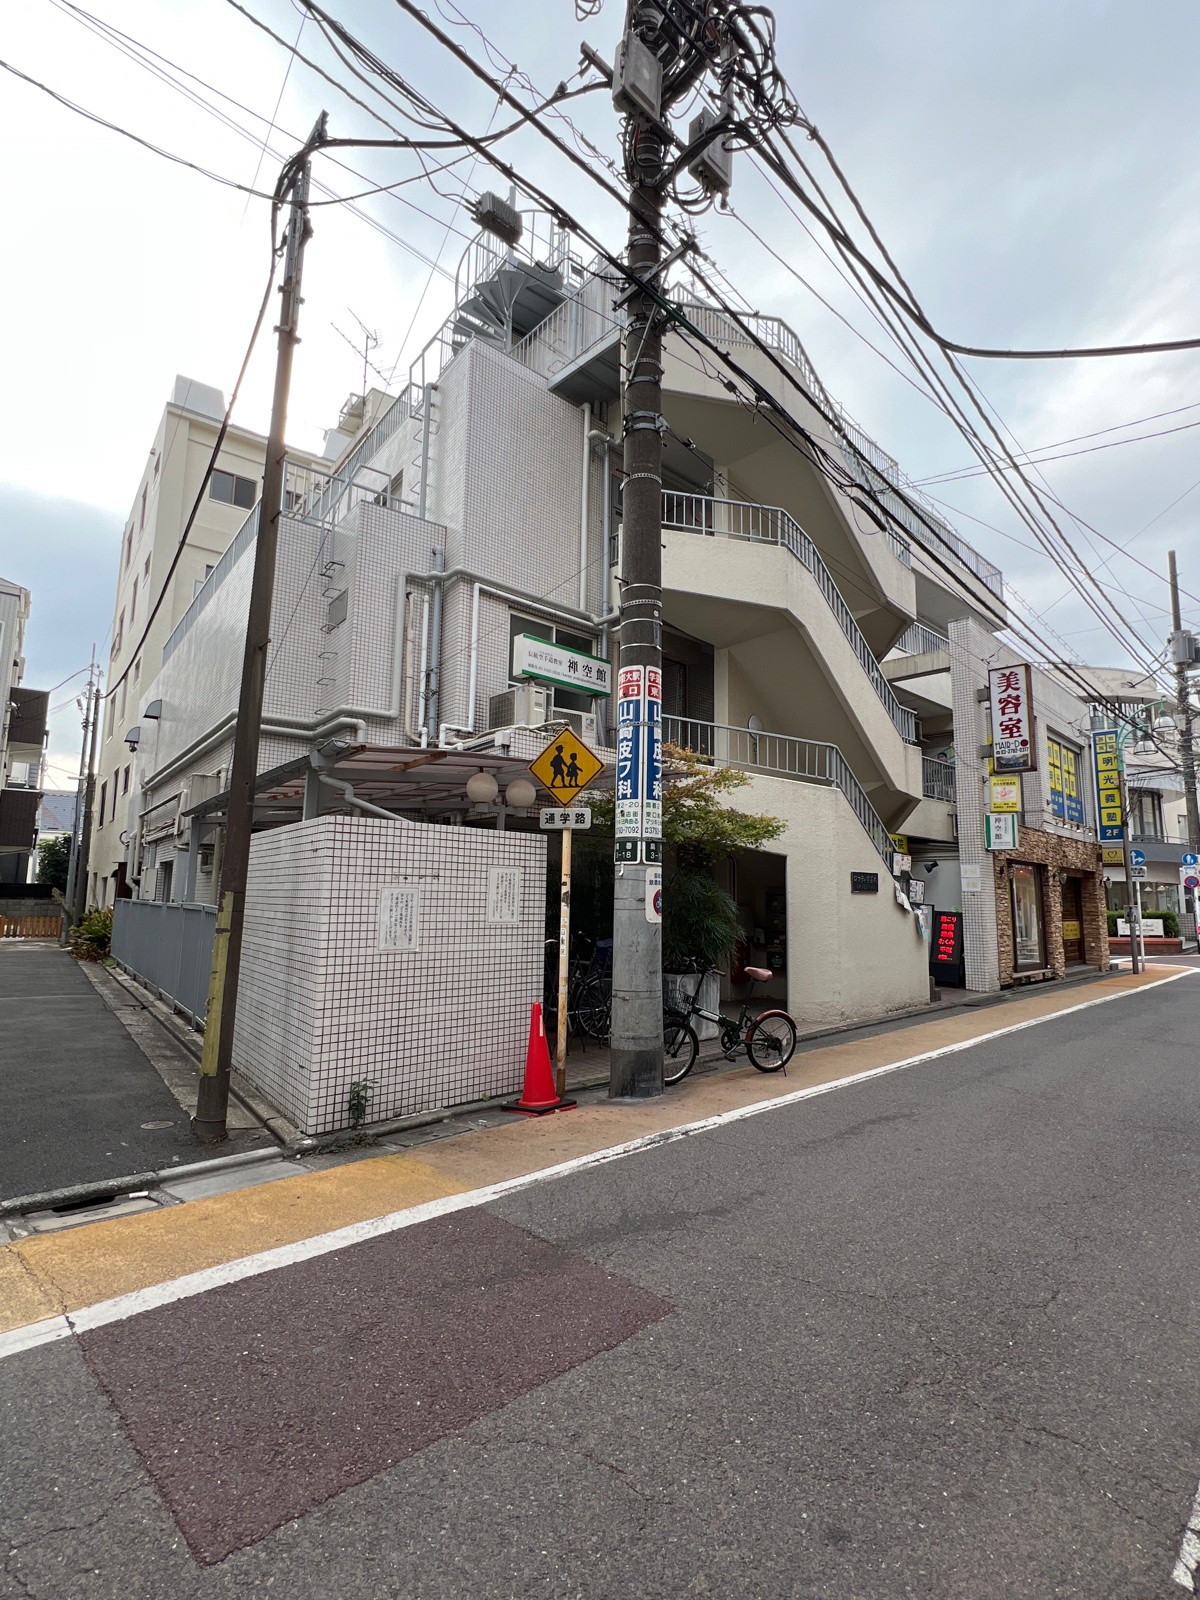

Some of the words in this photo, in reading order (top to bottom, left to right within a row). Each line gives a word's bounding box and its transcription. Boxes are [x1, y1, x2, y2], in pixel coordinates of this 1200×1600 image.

[997, 671, 1023, 739] 美容室
[1102, 756, 1117, 822] 明光義塾
[544, 812, 586, 825] 通学路
[1106, 829, 1119, 837] 2F
